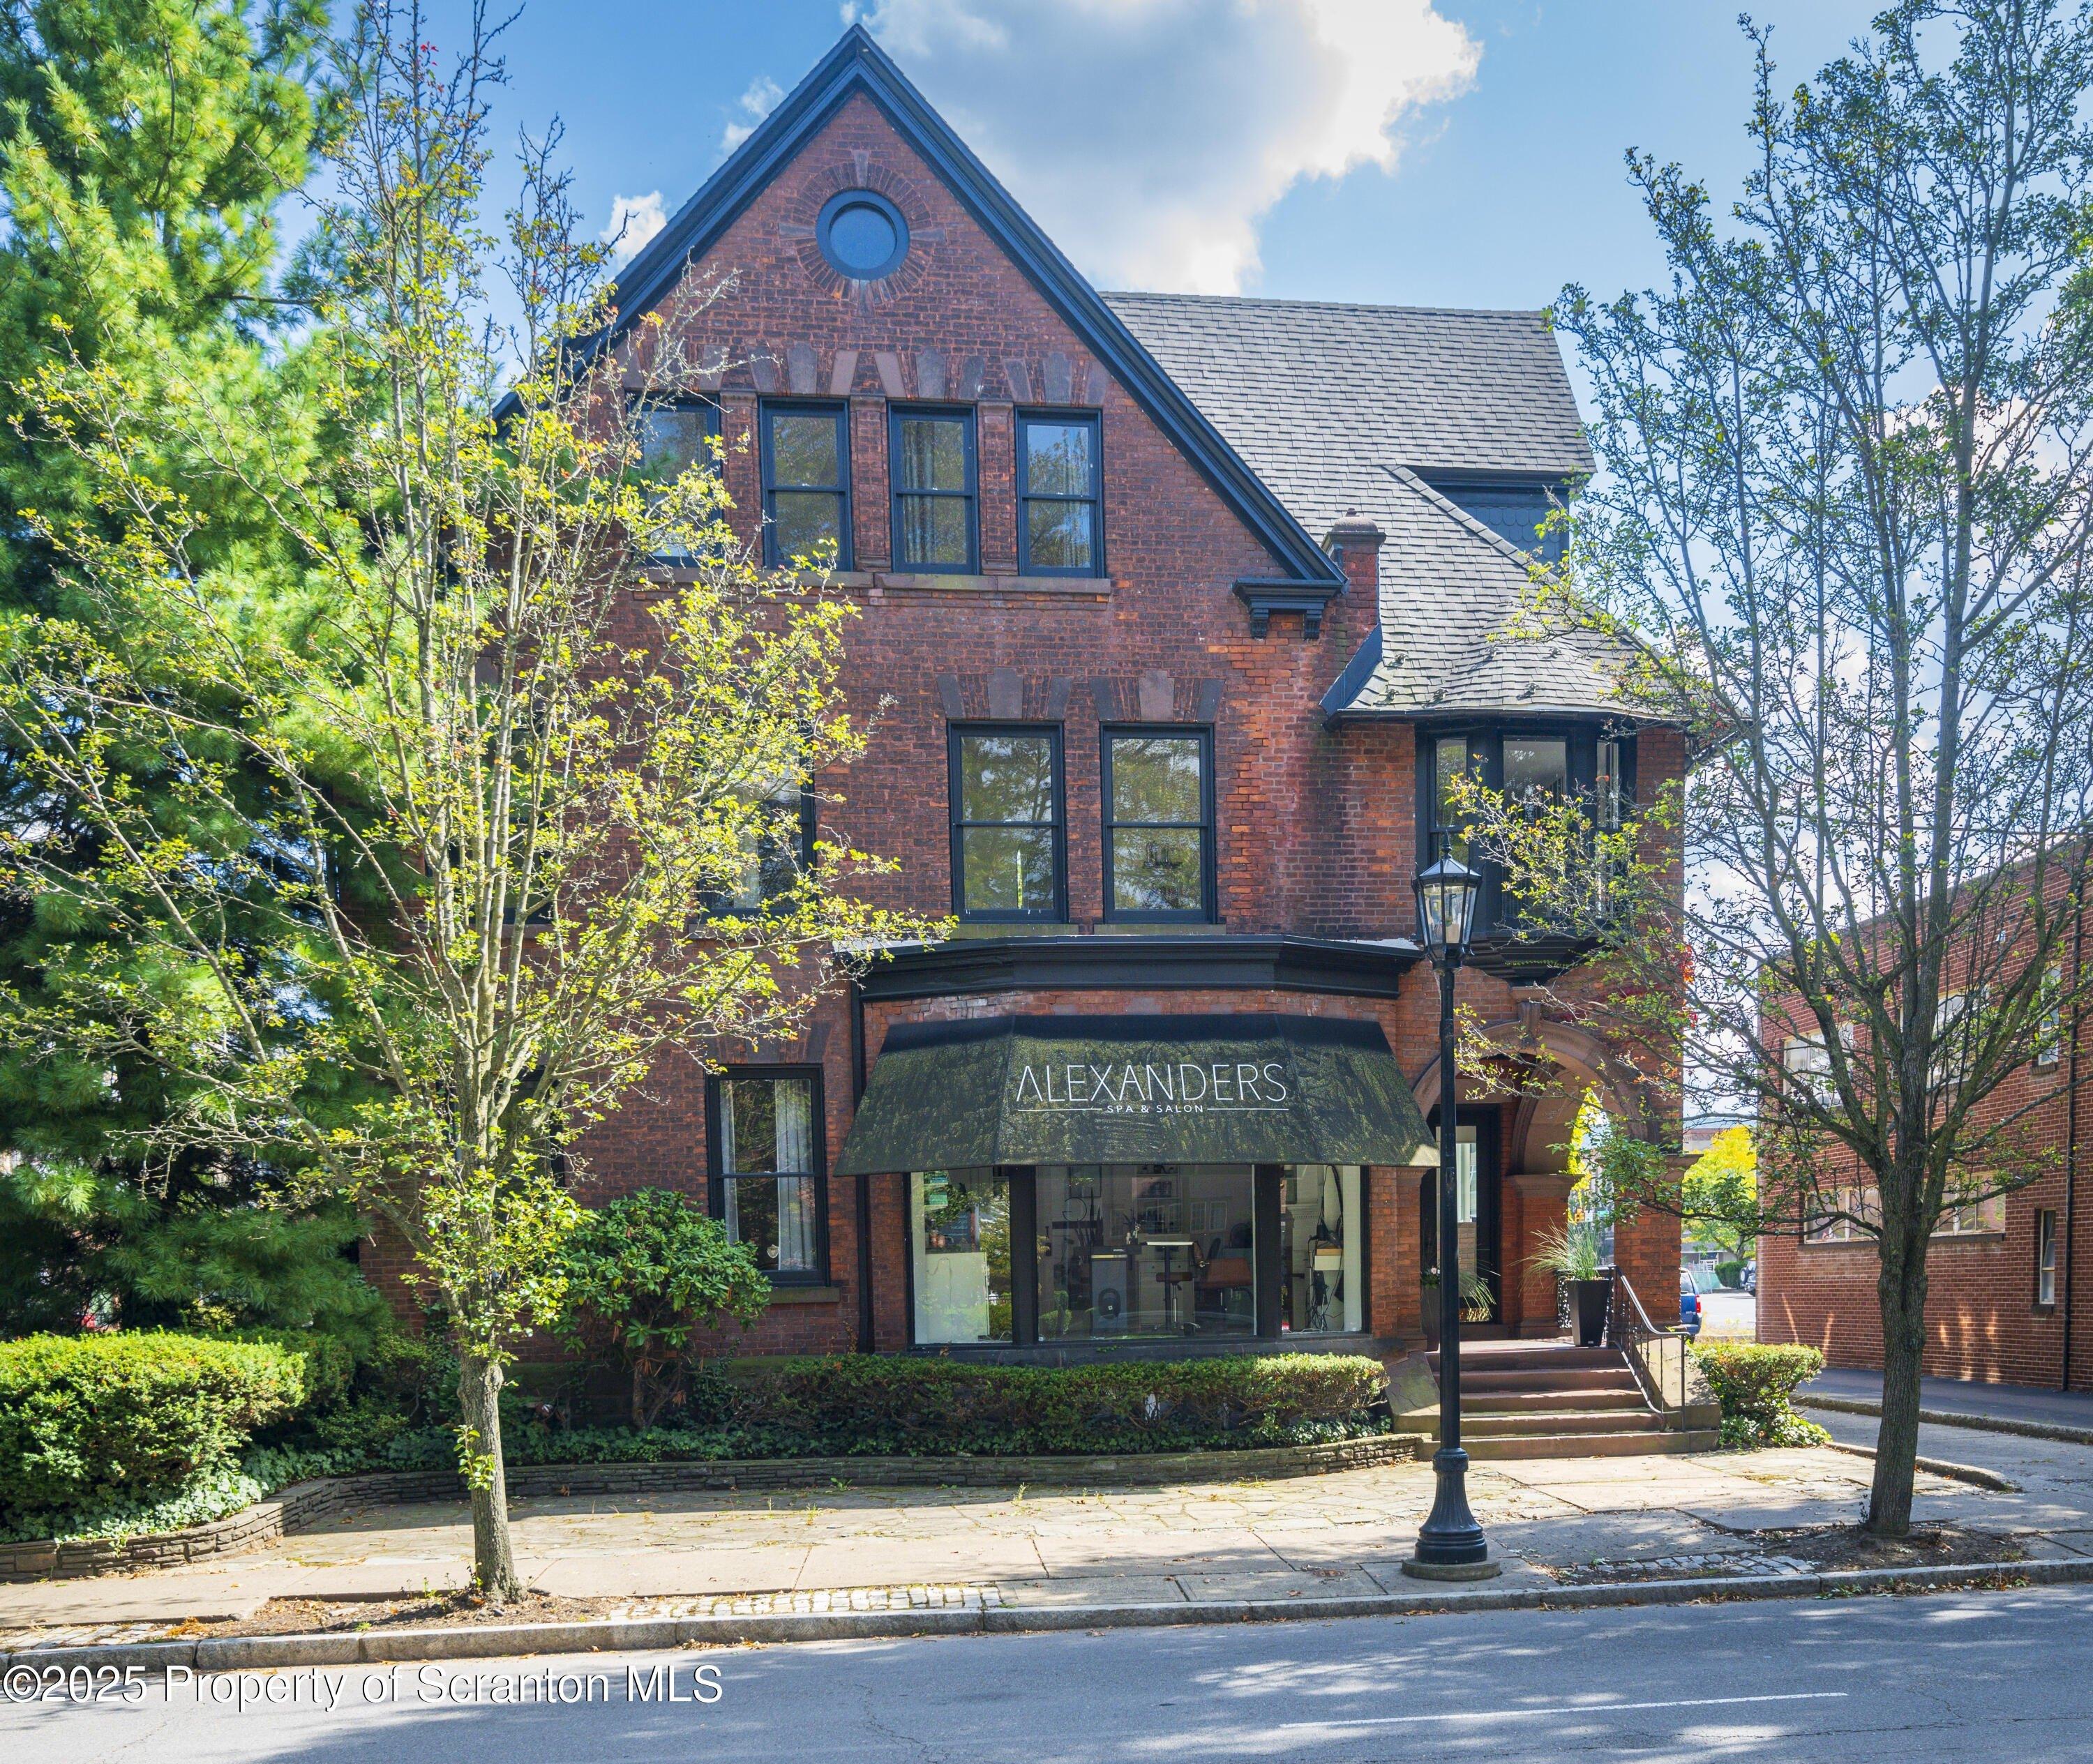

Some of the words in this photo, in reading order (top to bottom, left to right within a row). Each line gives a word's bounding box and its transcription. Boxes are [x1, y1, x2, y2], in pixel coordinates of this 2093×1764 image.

[1016, 1064, 1286, 1102] ALEXANDERS
[1106, 1104, 1134, 1114] SPA
[1140, 1104, 1150, 1113] &
[1156, 1104, 1203, 1114] SALON
